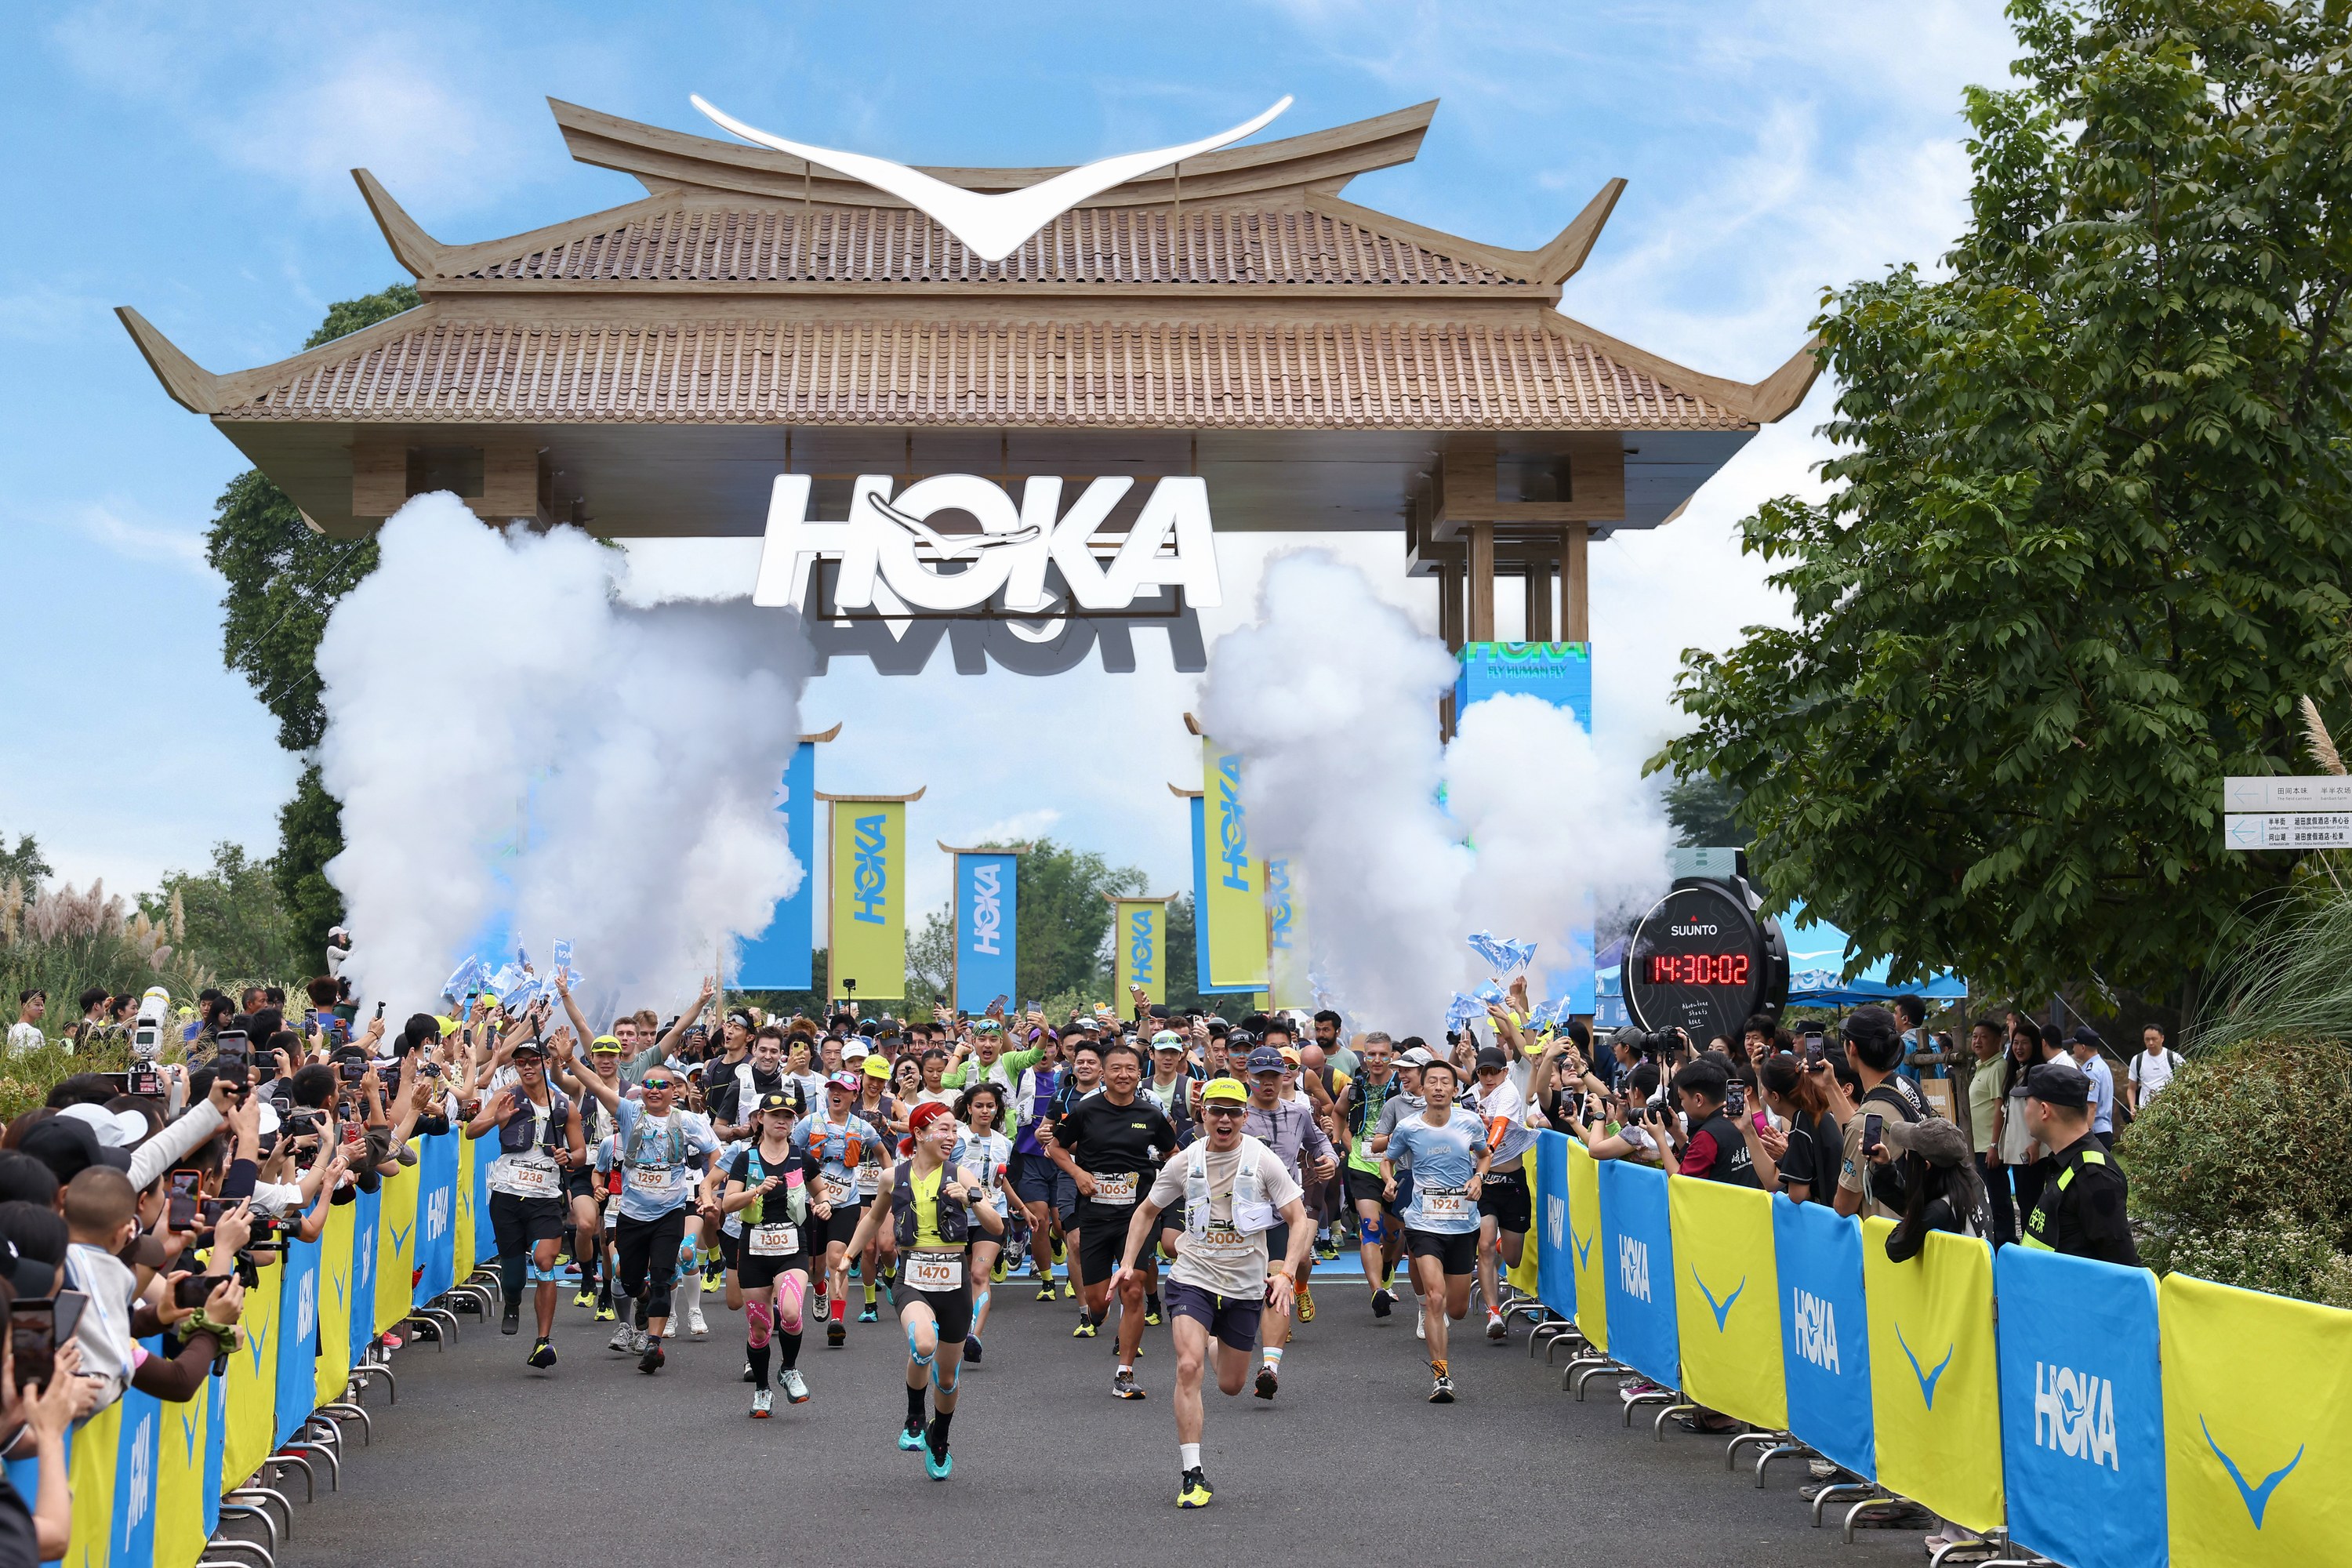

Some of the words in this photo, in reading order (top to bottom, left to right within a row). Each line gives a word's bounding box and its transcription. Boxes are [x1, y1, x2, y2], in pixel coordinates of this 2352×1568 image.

[753, 474, 1222, 609] HOKA
[1487, 666, 1504, 679] FLY
[1506, 666, 1548, 680] HUMAN
[1549, 666, 1567, 679] FLY
[1218, 753, 1249, 891] HOKA
[854, 814, 886, 925] HOKA
[973, 863, 1001, 956] HOKA
[1671, 924, 1718, 937] SUUNTO
[1131, 909, 1154, 984] HOKA
[1655, 954, 1749, 985] 14:30:02
[1427, 1145, 1452, 1156] HOKA
[518, 1171, 543, 1183] 1238
[637, 1172, 662, 1184] 1299
[1100, 1184, 1127, 1194] 1063
[1432, 1199, 1460, 1210] 1924
[760, 1233, 789, 1245] 1303
[1207, 1231, 1244, 1244] 5003
[917, 1266, 950, 1279] 1470
[1618, 1234, 1651, 1303] HOKA
[1794, 1287, 1840, 1376] HOKA
[2034, 1361, 2119, 1472] HOKA
